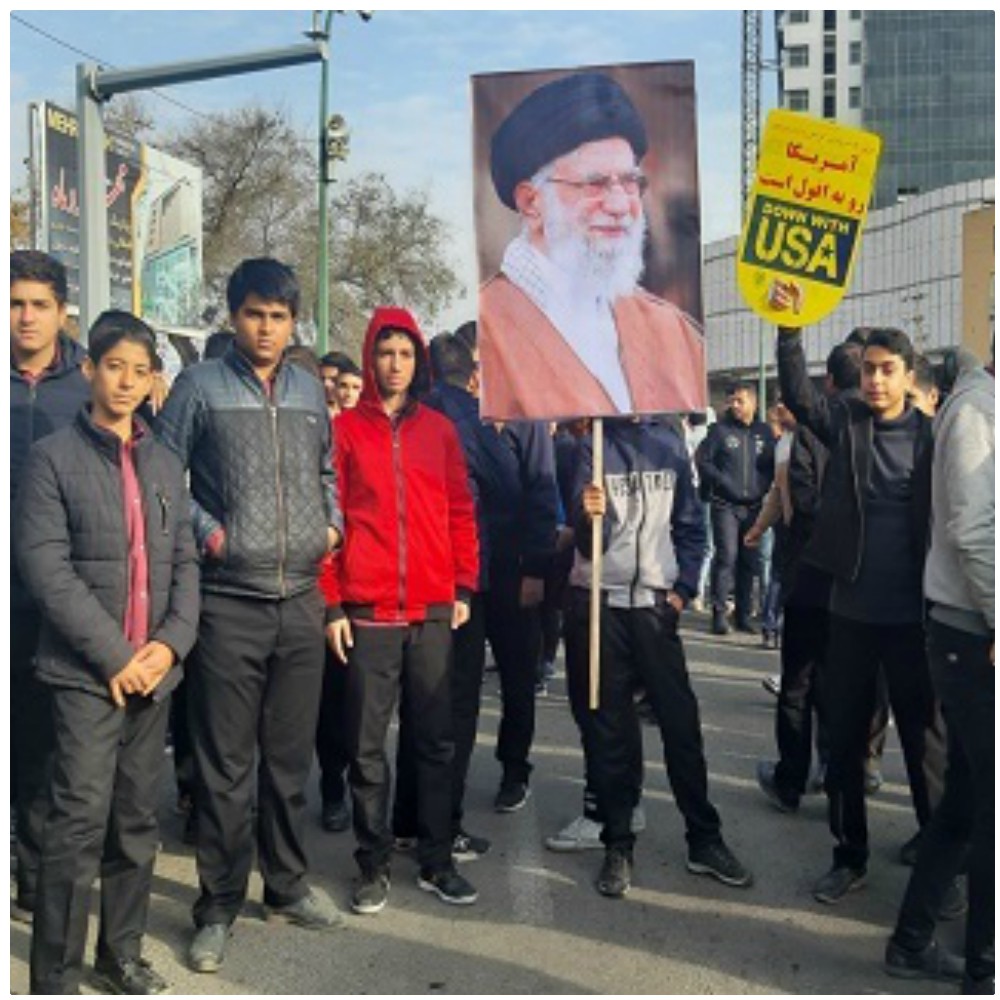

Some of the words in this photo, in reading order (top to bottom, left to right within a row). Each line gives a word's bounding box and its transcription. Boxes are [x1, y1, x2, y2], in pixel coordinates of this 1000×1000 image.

[761, 202, 808, 224] DOWN
[810, 213, 851, 235] WITH
[754, 214, 839, 279] USA
